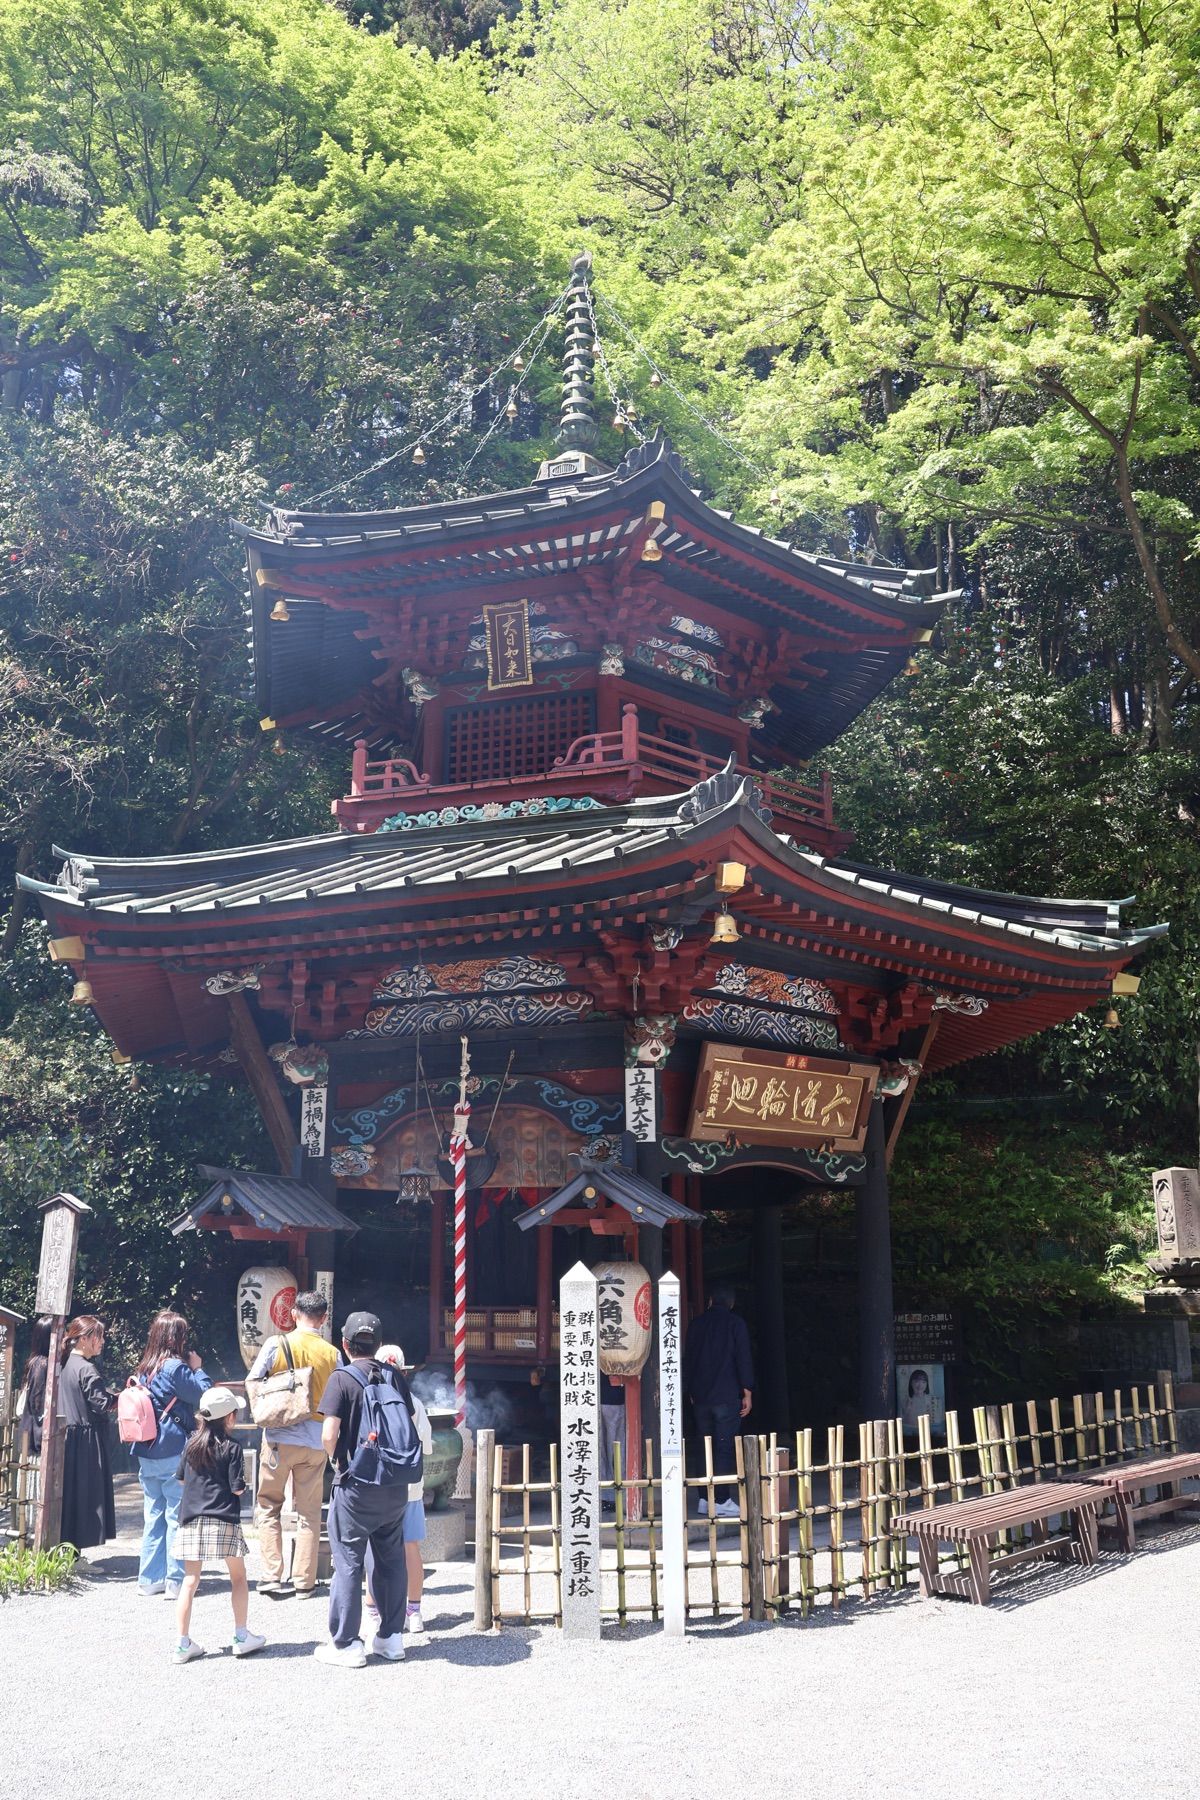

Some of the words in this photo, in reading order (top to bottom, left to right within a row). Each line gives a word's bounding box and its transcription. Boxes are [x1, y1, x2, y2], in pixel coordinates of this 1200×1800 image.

[502, 615, 522, 678] 大日如来
[304, 1090, 323, 1156] 転禍為福
[629, 1069, 652, 1141] 立春大吉
[239, 1277, 263, 1348] 六角堂
[599, 1273, 628, 1351] 六角堂
[562, 1311, 580, 1407] 重要文化財
[578, 1311, 596, 1407] 群馬県指定
[661, 1306, 679, 1445] 世界人類が平和でありますように
[567, 1417, 594, 1598] 水澤寺六角二重塔
